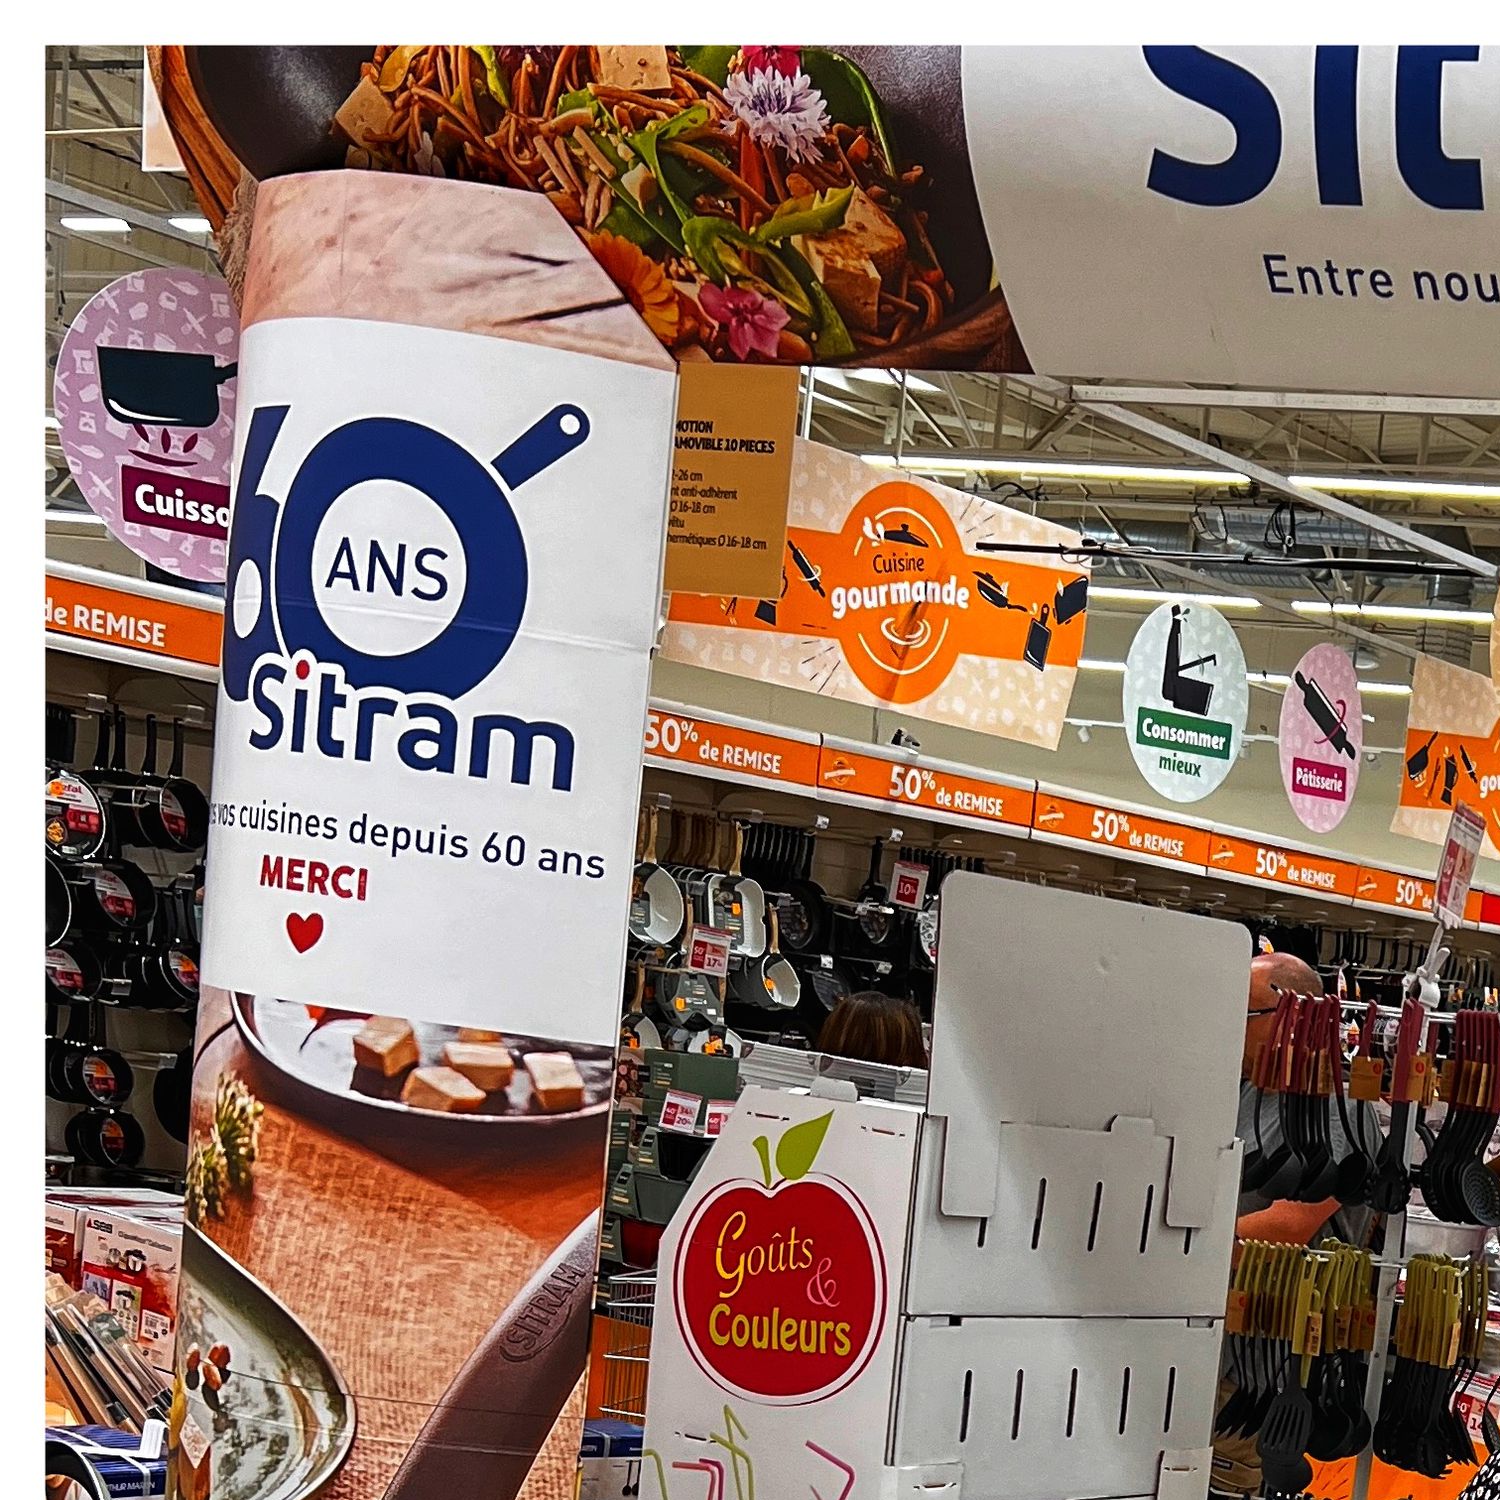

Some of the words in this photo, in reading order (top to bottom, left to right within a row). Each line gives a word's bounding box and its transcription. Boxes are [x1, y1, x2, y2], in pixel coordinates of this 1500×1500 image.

[1262, 253, 1394, 299] Entre
[739, 439, 776, 454] PIECES
[325, 537, 450, 602] ANS
[872, 552, 925, 574] Cuisine
[831, 575, 970, 619] gourmande
[73, 604, 167, 647] REMISE
[248, 658, 576, 793] Sitram
[1142, 716, 1227, 752] Consommer
[699, 740, 719, 762] de
[722, 744, 783, 774] REMISE
[1158, 753, 1202, 778] mieux
[1295, 763, 1344, 794] Pâtisserie
[889, 766, 936, 801] 50%
[936, 785, 952, 806] de
[954, 788, 1004, 817] REMISE
[239, 800, 338, 840] cuisines
[349, 813, 469, 859] depuis
[482, 832, 526, 867] 60
[538, 846, 605, 879] ans
[1091, 810, 1129, 843] 50%
[1129, 826, 1143, 846] de
[1145, 830, 1184, 857] REMISE
[260, 854, 369, 901] MERCI
[1255, 848, 1288, 878] 50%
[1287, 864, 1300, 883] de
[1301, 866, 1337, 890] REMISE
[1395, 879, 1423, 906] 50%
[716, 1210, 814, 1297] Goûts
[806, 1257, 840, 1307] &
[506, 1263, 587, 1351] SITRAM
[708, 1305, 853, 1357] Couleurs
